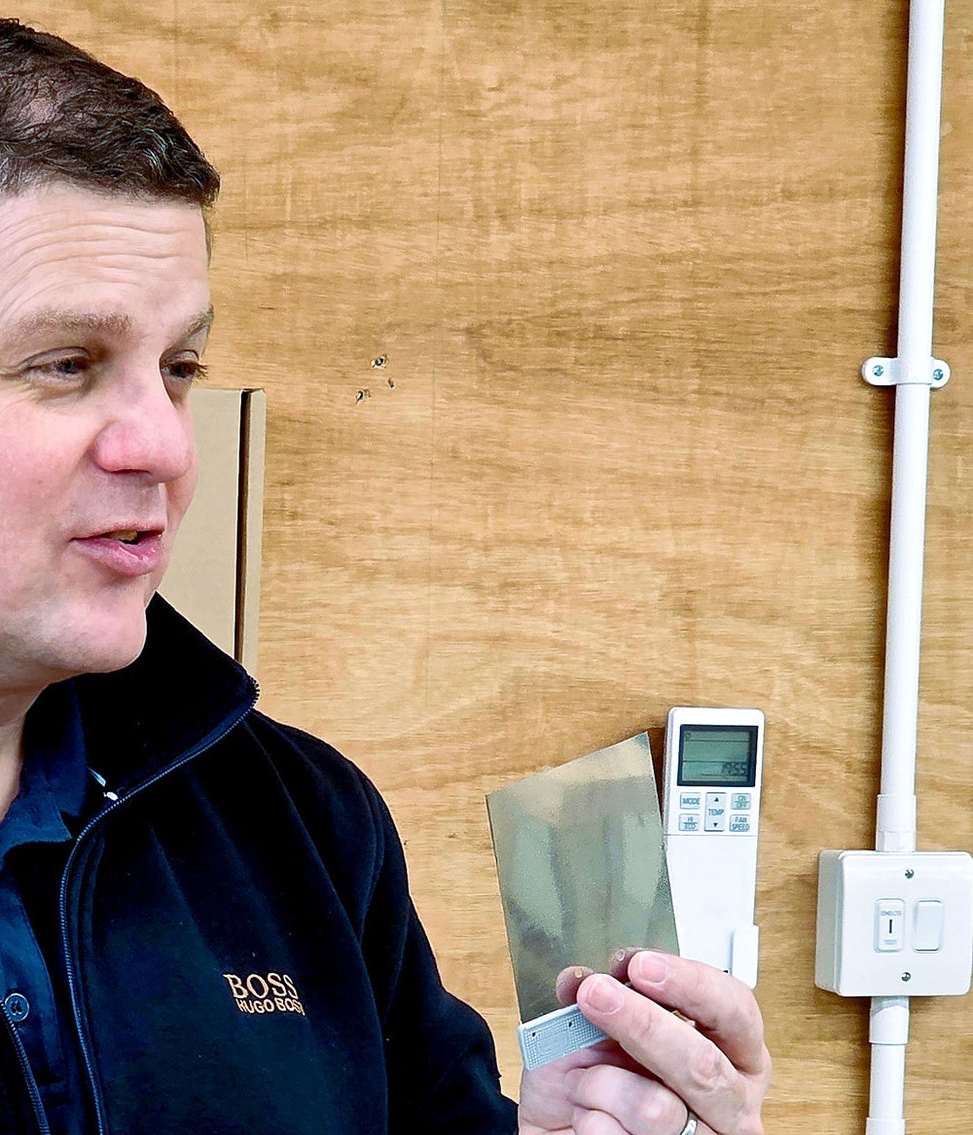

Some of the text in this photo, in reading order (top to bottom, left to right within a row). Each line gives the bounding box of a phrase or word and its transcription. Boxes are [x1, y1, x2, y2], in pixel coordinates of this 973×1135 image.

[682, 797, 701, 805] MODE
[708, 808, 725, 816] TEMP
[731, 823, 750, 831] SPEED
[222, 972, 299, 999] BOSS
[235, 998, 275, 1014] HUGO
